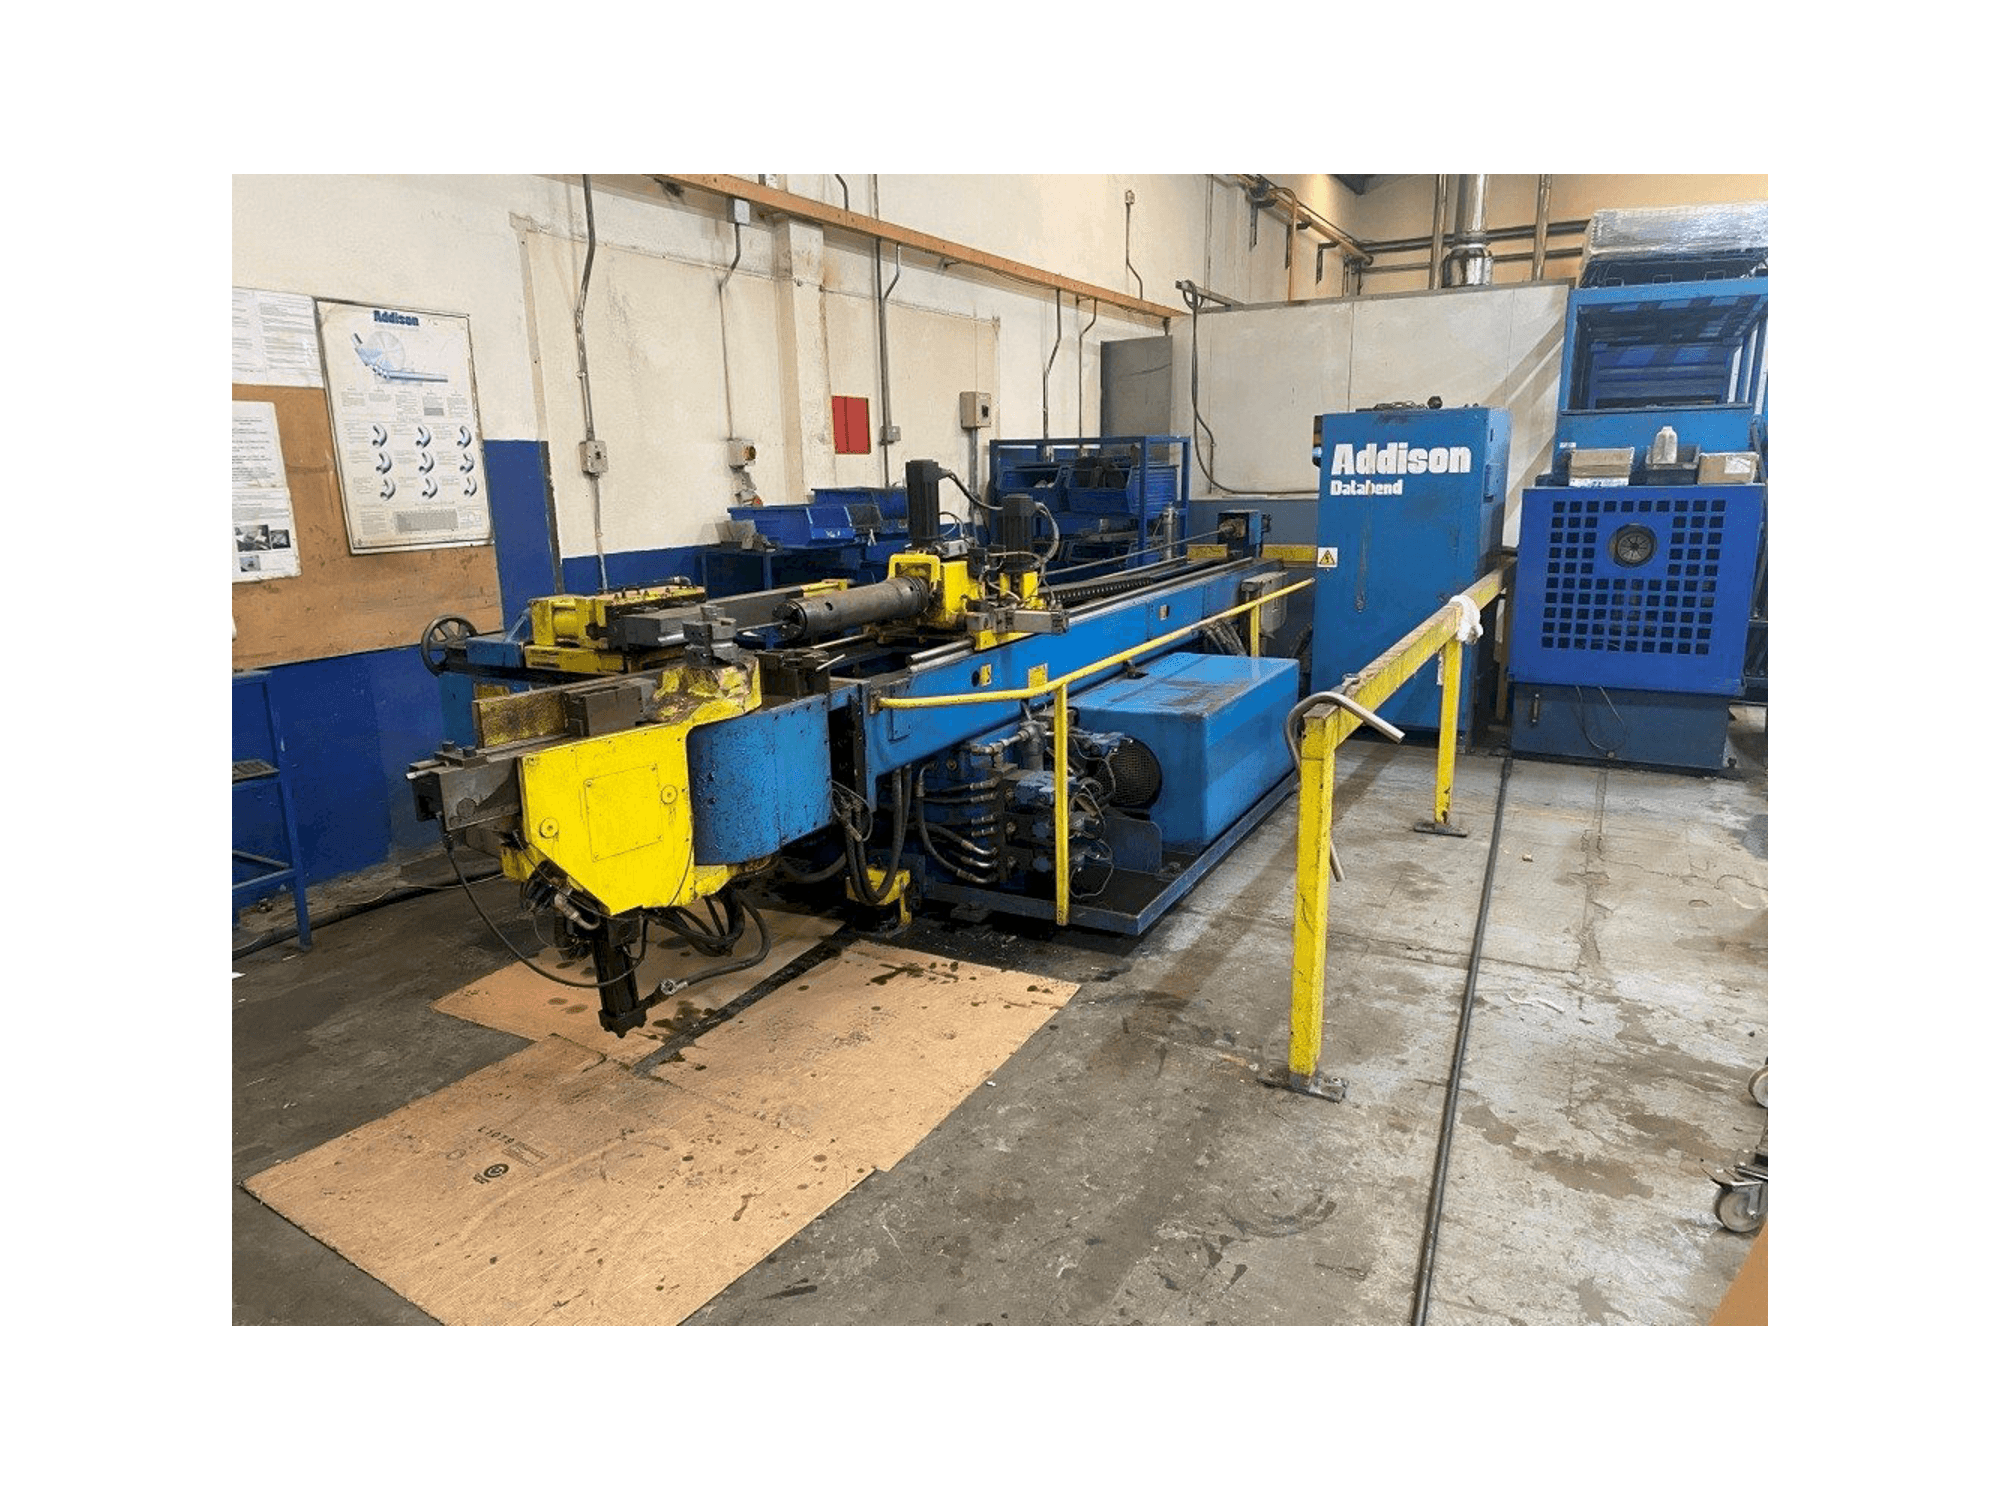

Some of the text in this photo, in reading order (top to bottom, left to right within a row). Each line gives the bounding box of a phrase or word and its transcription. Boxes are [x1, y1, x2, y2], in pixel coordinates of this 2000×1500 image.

[373, 310, 419, 326] Addison
[1331, 442, 1472, 475] Addison
[1330, 479, 1403, 496] Databend
